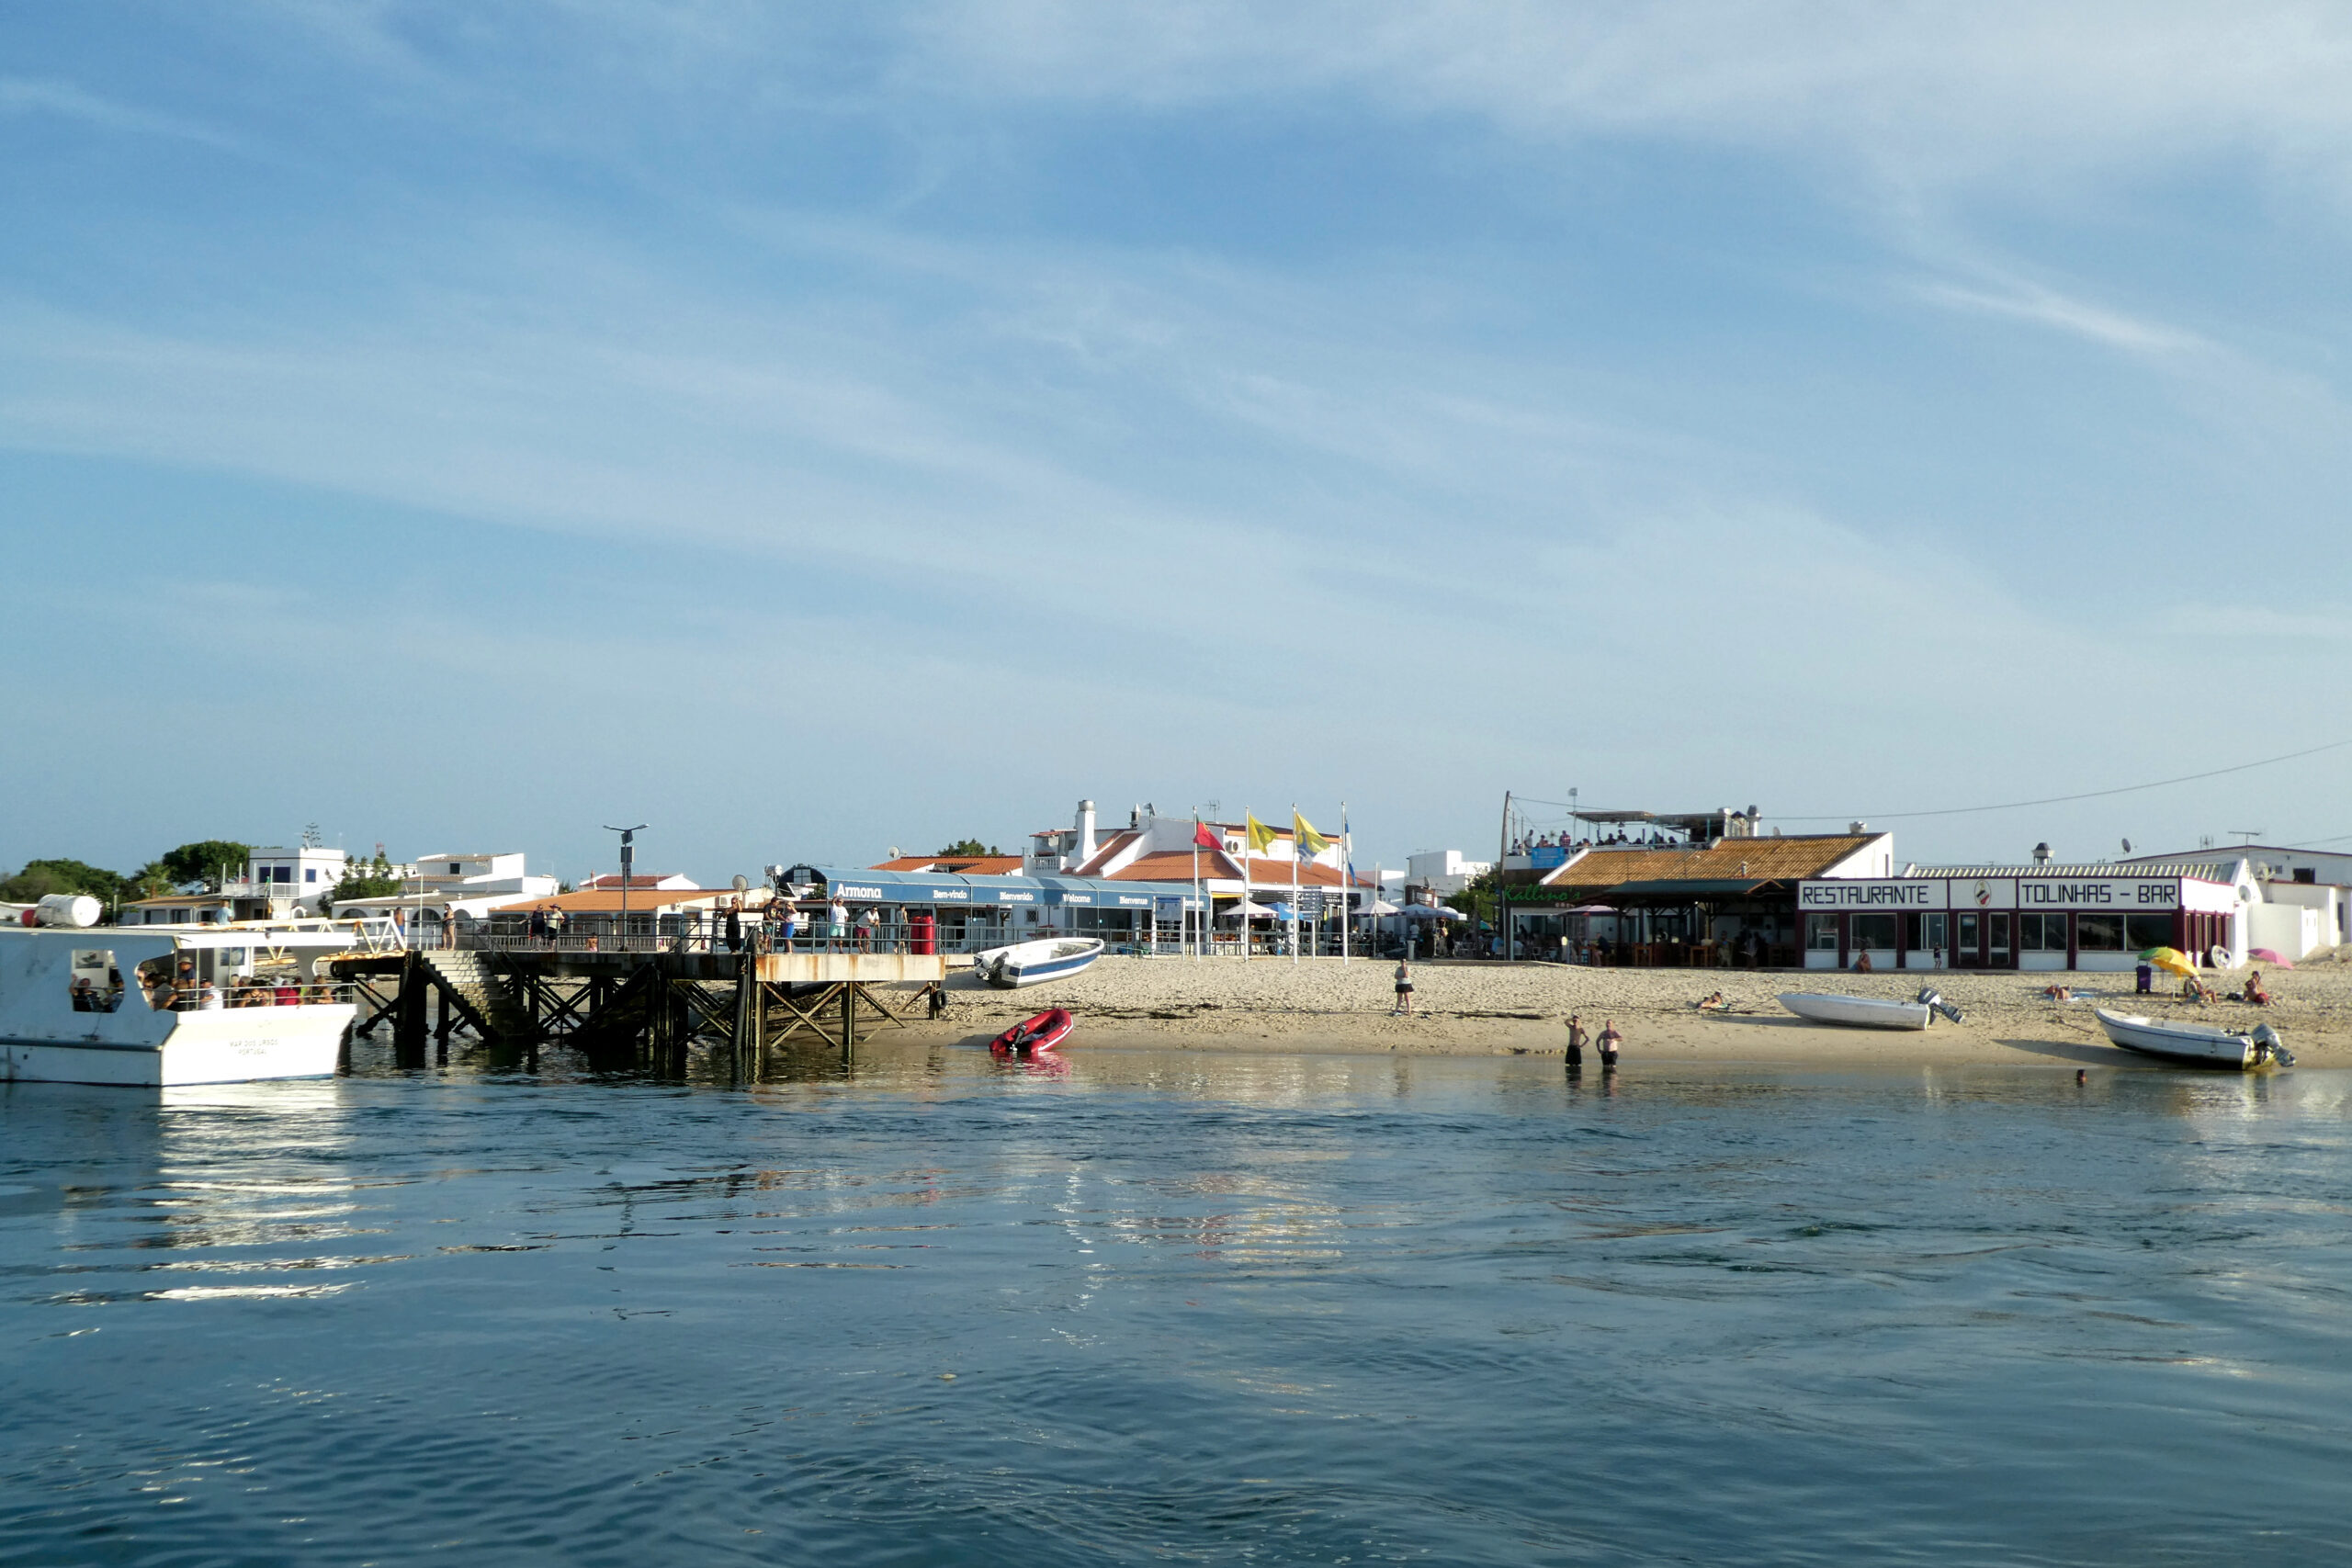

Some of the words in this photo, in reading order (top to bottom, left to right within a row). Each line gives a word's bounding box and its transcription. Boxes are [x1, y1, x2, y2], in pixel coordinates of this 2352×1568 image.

[837, 884, 882, 898] Armona
[933, 889, 967, 899] Bem-vindo
[1803, 886, 1929, 904] RESTAURANTE
[2021, 884, 2111, 903] TOLINHAS
[2137, 884, 2176, 903] BAR
[1000, 892, 1034, 901] Bienvenido
[1062, 893, 1091, 903] Welcome
[1119, 896, 1148, 905] Bienvenue
